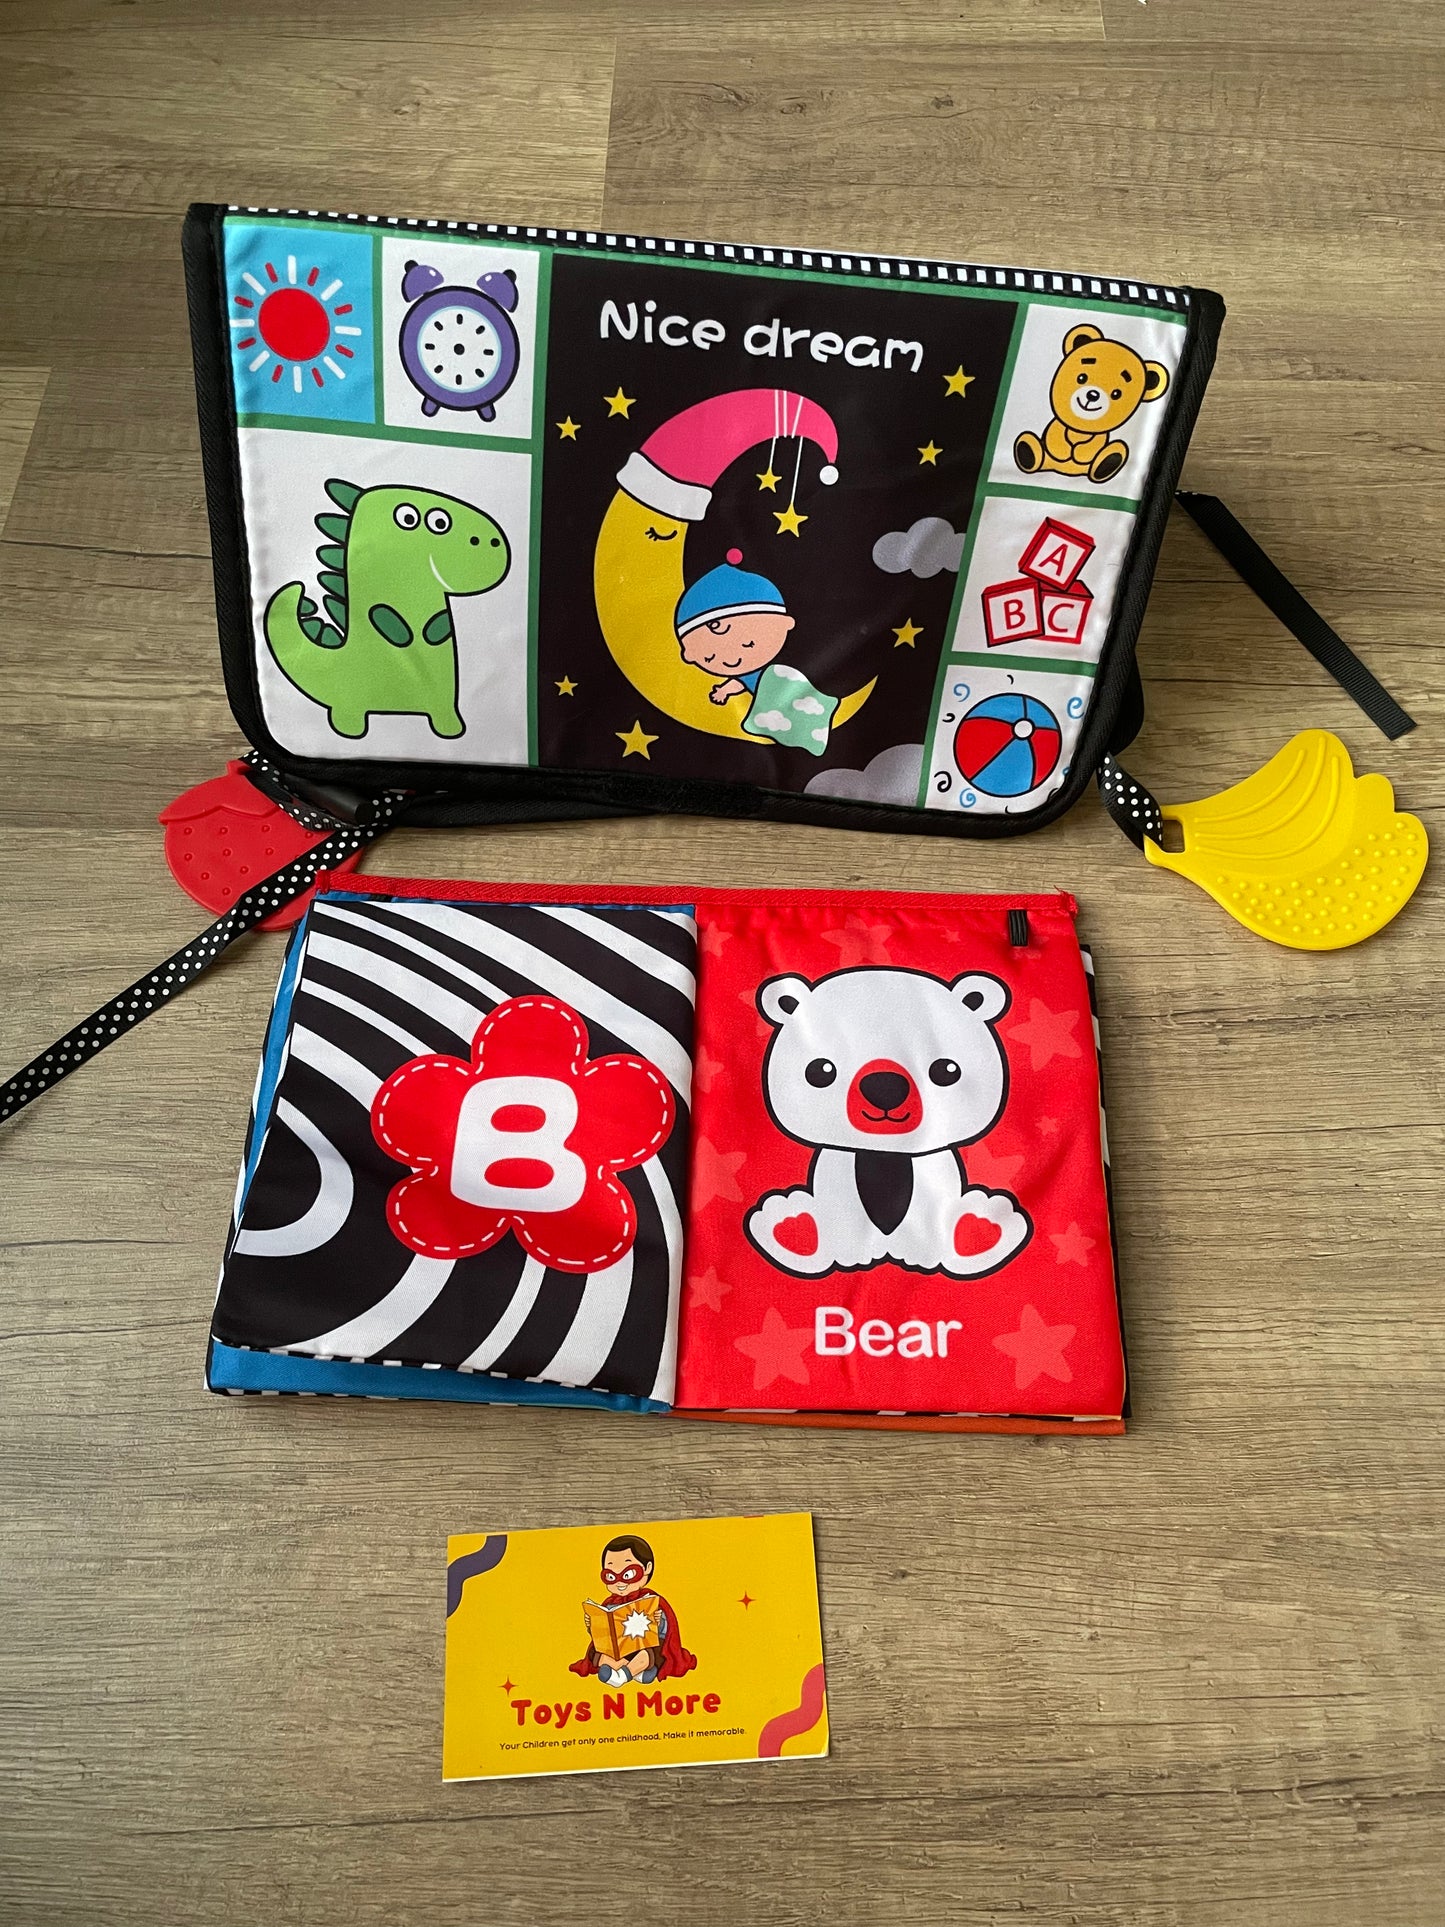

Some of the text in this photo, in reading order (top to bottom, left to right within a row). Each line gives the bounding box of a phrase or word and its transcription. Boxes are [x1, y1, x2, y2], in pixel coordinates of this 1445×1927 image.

[600, 299, 924, 373] Nice dream
[1037, 543, 1069, 577] A
[1003, 599, 1075, 633] B C
[450, 1075, 587, 1213] B
[815, 1306, 963, 1359] Bear
[510, 1690, 722, 1729] Toys N More
[522, 1740, 559, 1749] Children
[561, 1738, 576, 1748] get
[578, 1736, 596, 1745] only
[598, 1736, 614, 1744] one
[663, 1731, 686, 1740] Make
[688, 1729, 694, 1738] it
